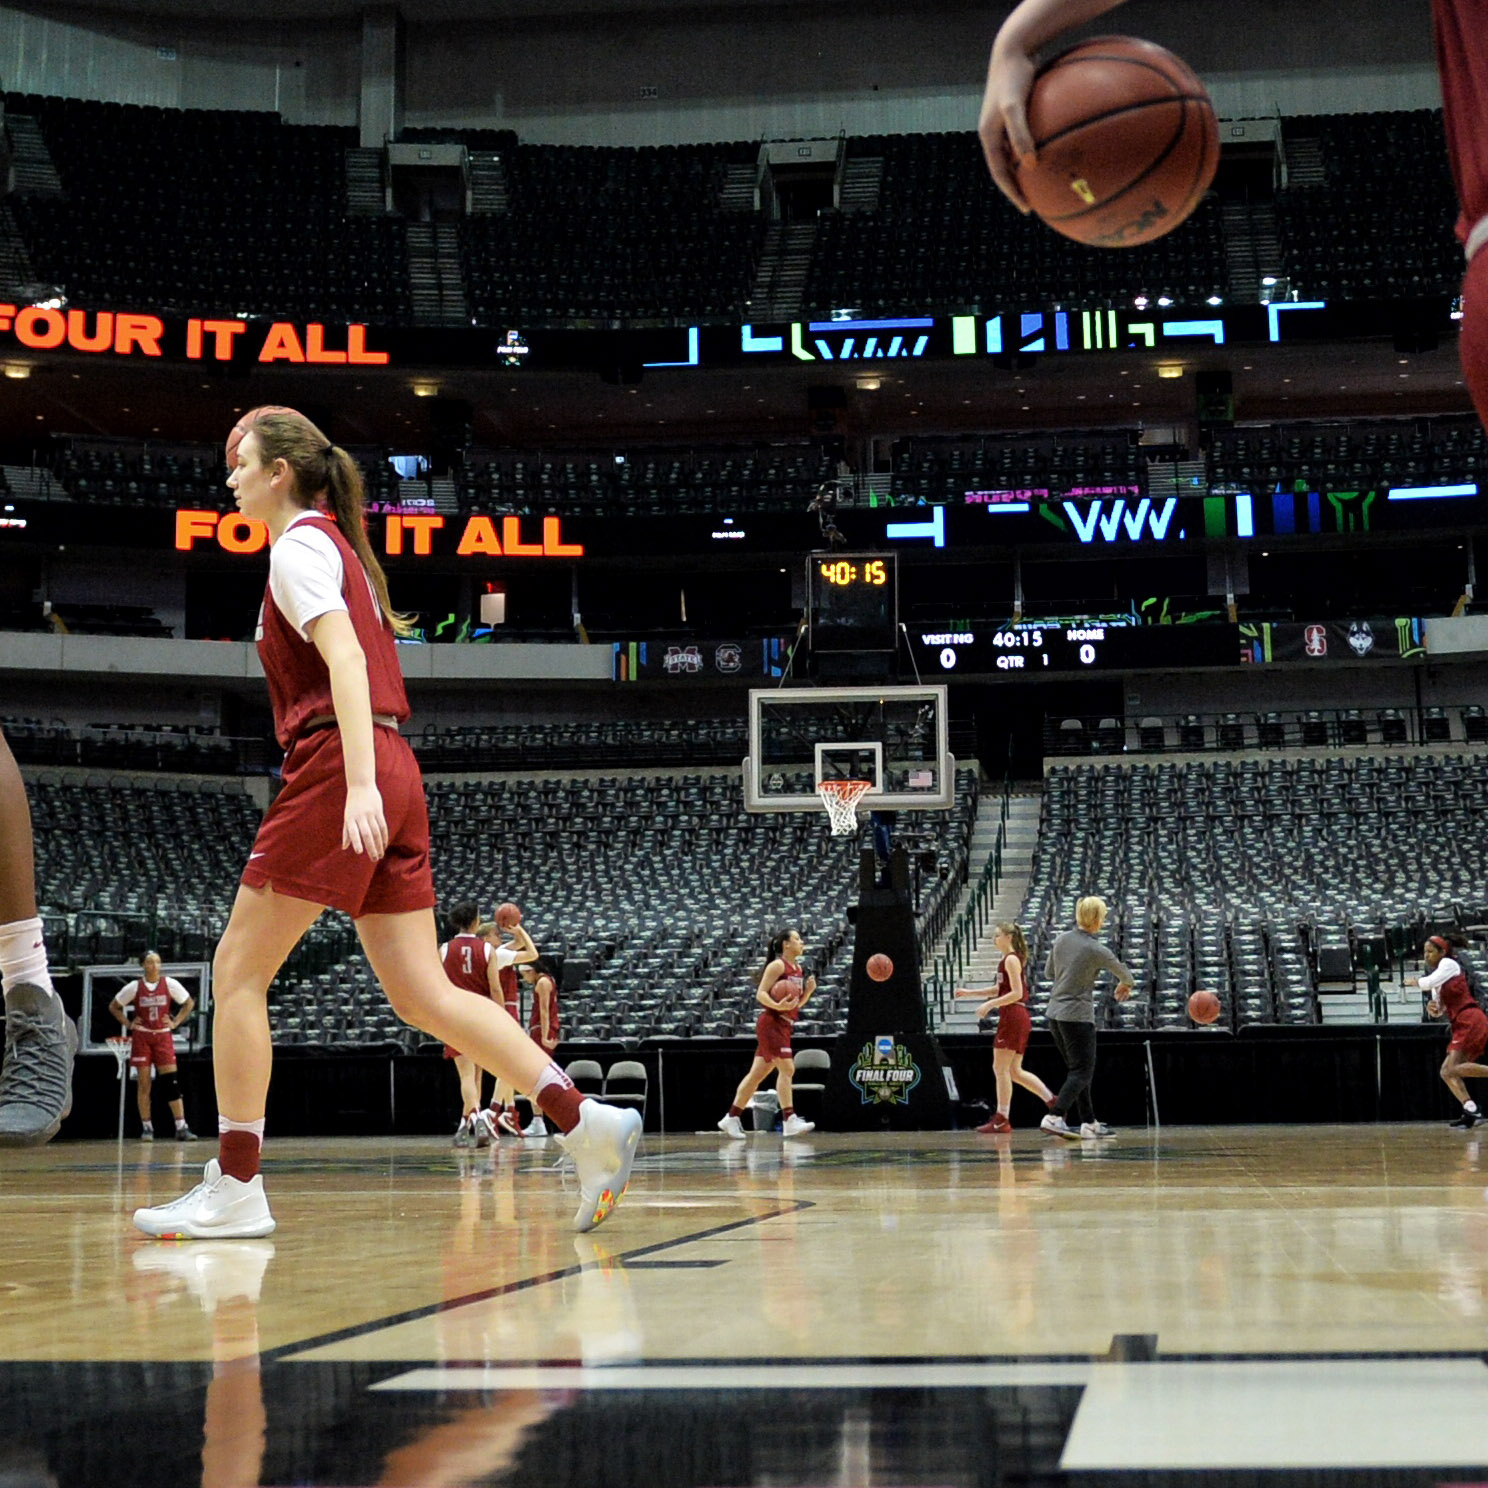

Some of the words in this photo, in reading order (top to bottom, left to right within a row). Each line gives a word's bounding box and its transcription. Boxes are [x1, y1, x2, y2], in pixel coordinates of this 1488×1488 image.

[186, 318, 246, 360] IT
[259, 322, 389, 365] ALL
[385, 514, 444, 555] IT
[456, 515, 584, 557] ALL
[992, 631, 1043, 647] 40:15
[1067, 628, 1105, 641] HOME
[940, 647, 957, 669] 0
[996, 655, 1025, 669] QTR
[1042, 654, 1049, 666] 1
[1079, 644, 1096, 663] 0
[461, 946, 472, 974] 3
[856, 1069, 885, 1082] FINAL
[885, 1069, 914, 1082] FOUR
